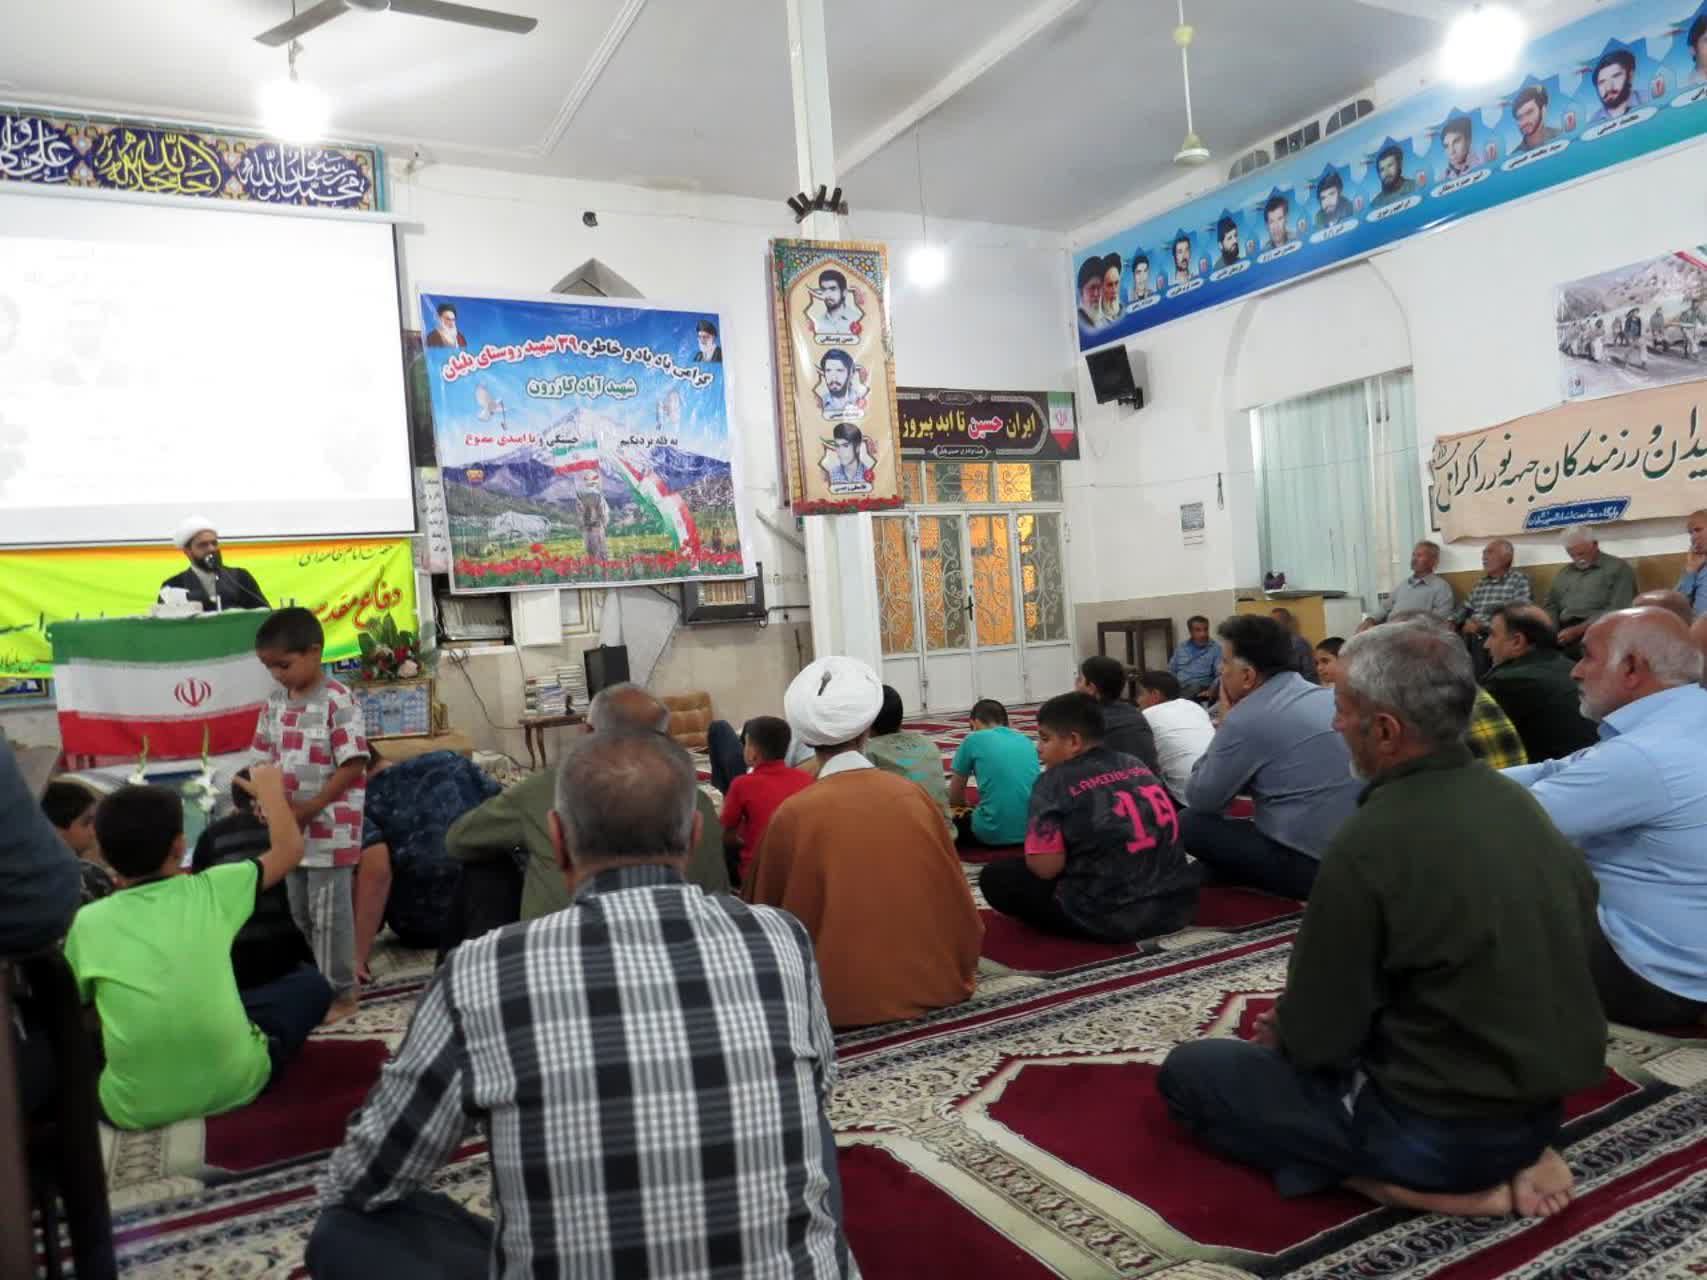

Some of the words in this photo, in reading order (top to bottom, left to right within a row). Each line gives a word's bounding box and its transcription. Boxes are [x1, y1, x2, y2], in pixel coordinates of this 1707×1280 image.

[524, 336, 557, 356] شهید
[557, 334, 579, 353] ۳۹
[580, 338, 623, 358] خاطره
[477, 345, 525, 368] روستای
[623, 348, 633, 363] و
[527, 375, 577, 397] کازرون
[576, 374, 605, 397] آباد
[605, 378, 638, 397] شهید
[672, 365, 714, 388] گرامی
[902, 409, 934, 439] پیروز
[935, 408, 954, 437] ابد
[956, 408, 967, 432] تا
[968, 416, 1004, 440] حسین
[1006, 409, 1037, 439] ایران
[1643, 405, 1707, 479] یدان
[1648, 424, 1663, 446] و
[1485, 432, 1512, 491] نور
[1499, 459, 1540, 505] جبهه
[352, 564, 402, 629] دفاع
[1112, 783, 1179, 854] 19
